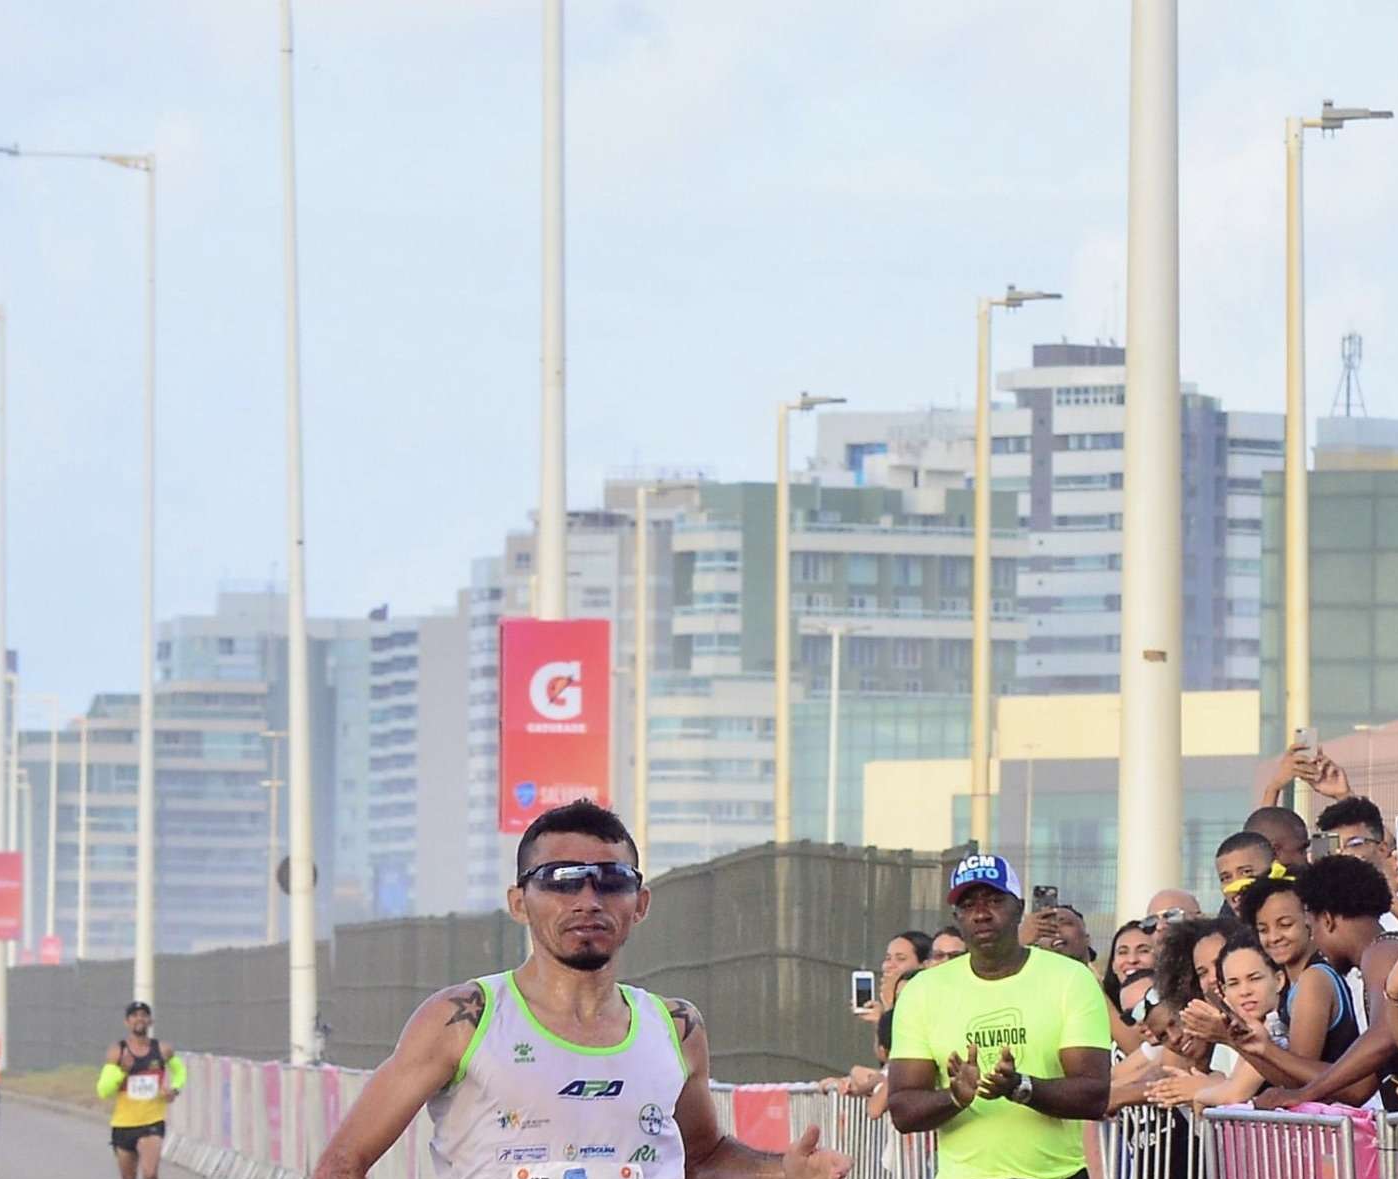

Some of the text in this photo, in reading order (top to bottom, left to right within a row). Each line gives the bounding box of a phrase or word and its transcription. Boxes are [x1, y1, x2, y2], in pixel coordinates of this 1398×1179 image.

[529, 661, 582, 720] G
[958, 856, 996, 875] ACM
[966, 1027, 1027, 1048] SALVADOR
